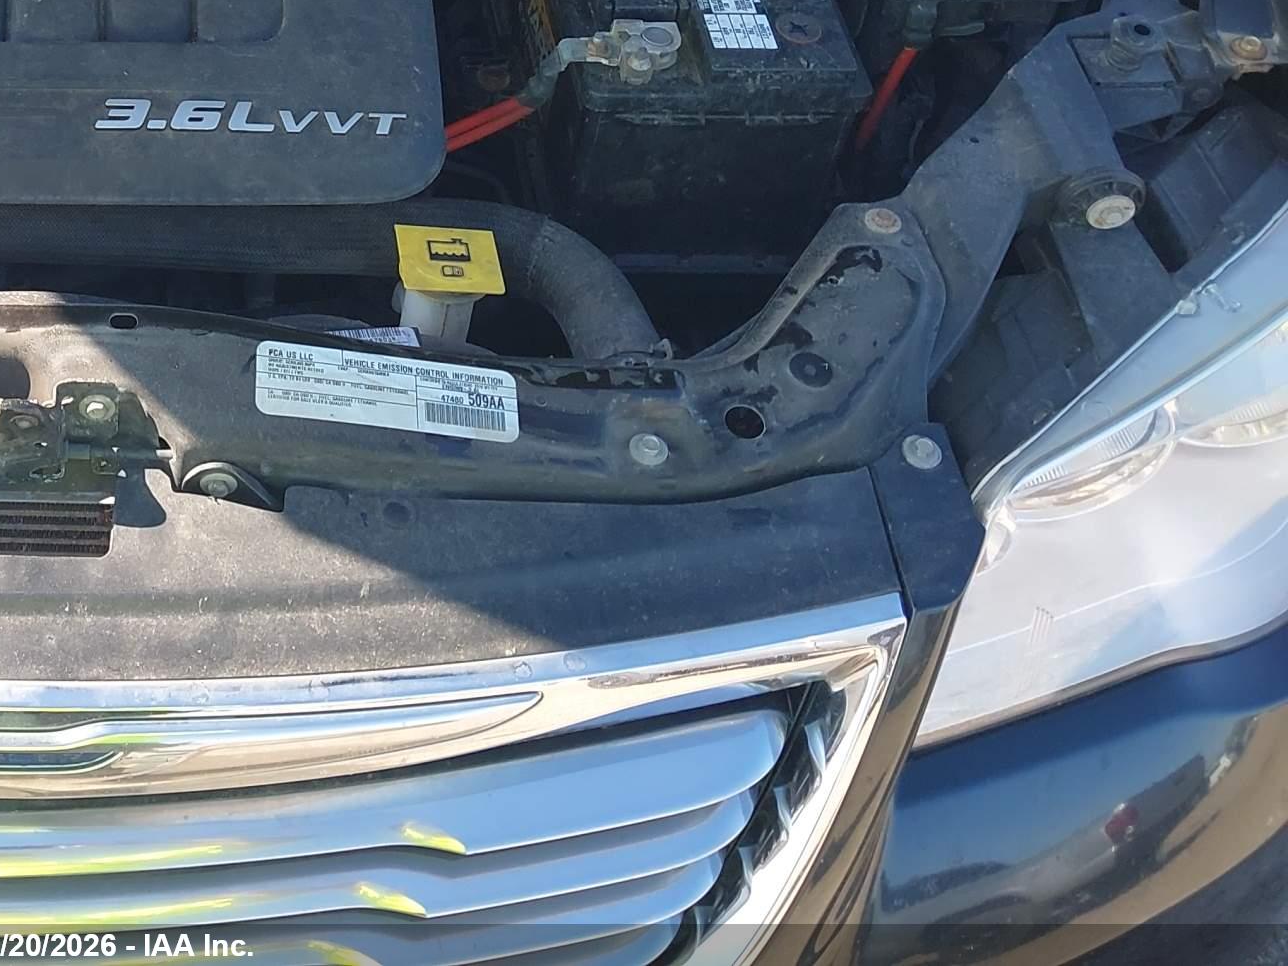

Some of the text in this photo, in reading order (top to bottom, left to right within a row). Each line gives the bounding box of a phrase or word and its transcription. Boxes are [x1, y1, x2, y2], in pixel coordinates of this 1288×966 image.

[286, 351, 297, 359] US
[299, 352, 314, 362] LLC
[344, 358, 375, 369] VEHICLE
[377, 361, 413, 374] EMISSION
[415, 367, 449, 379] CONTROL
[452, 372, 504, 386] INFORMATION
[468, 393, 505, 410] 509AA
